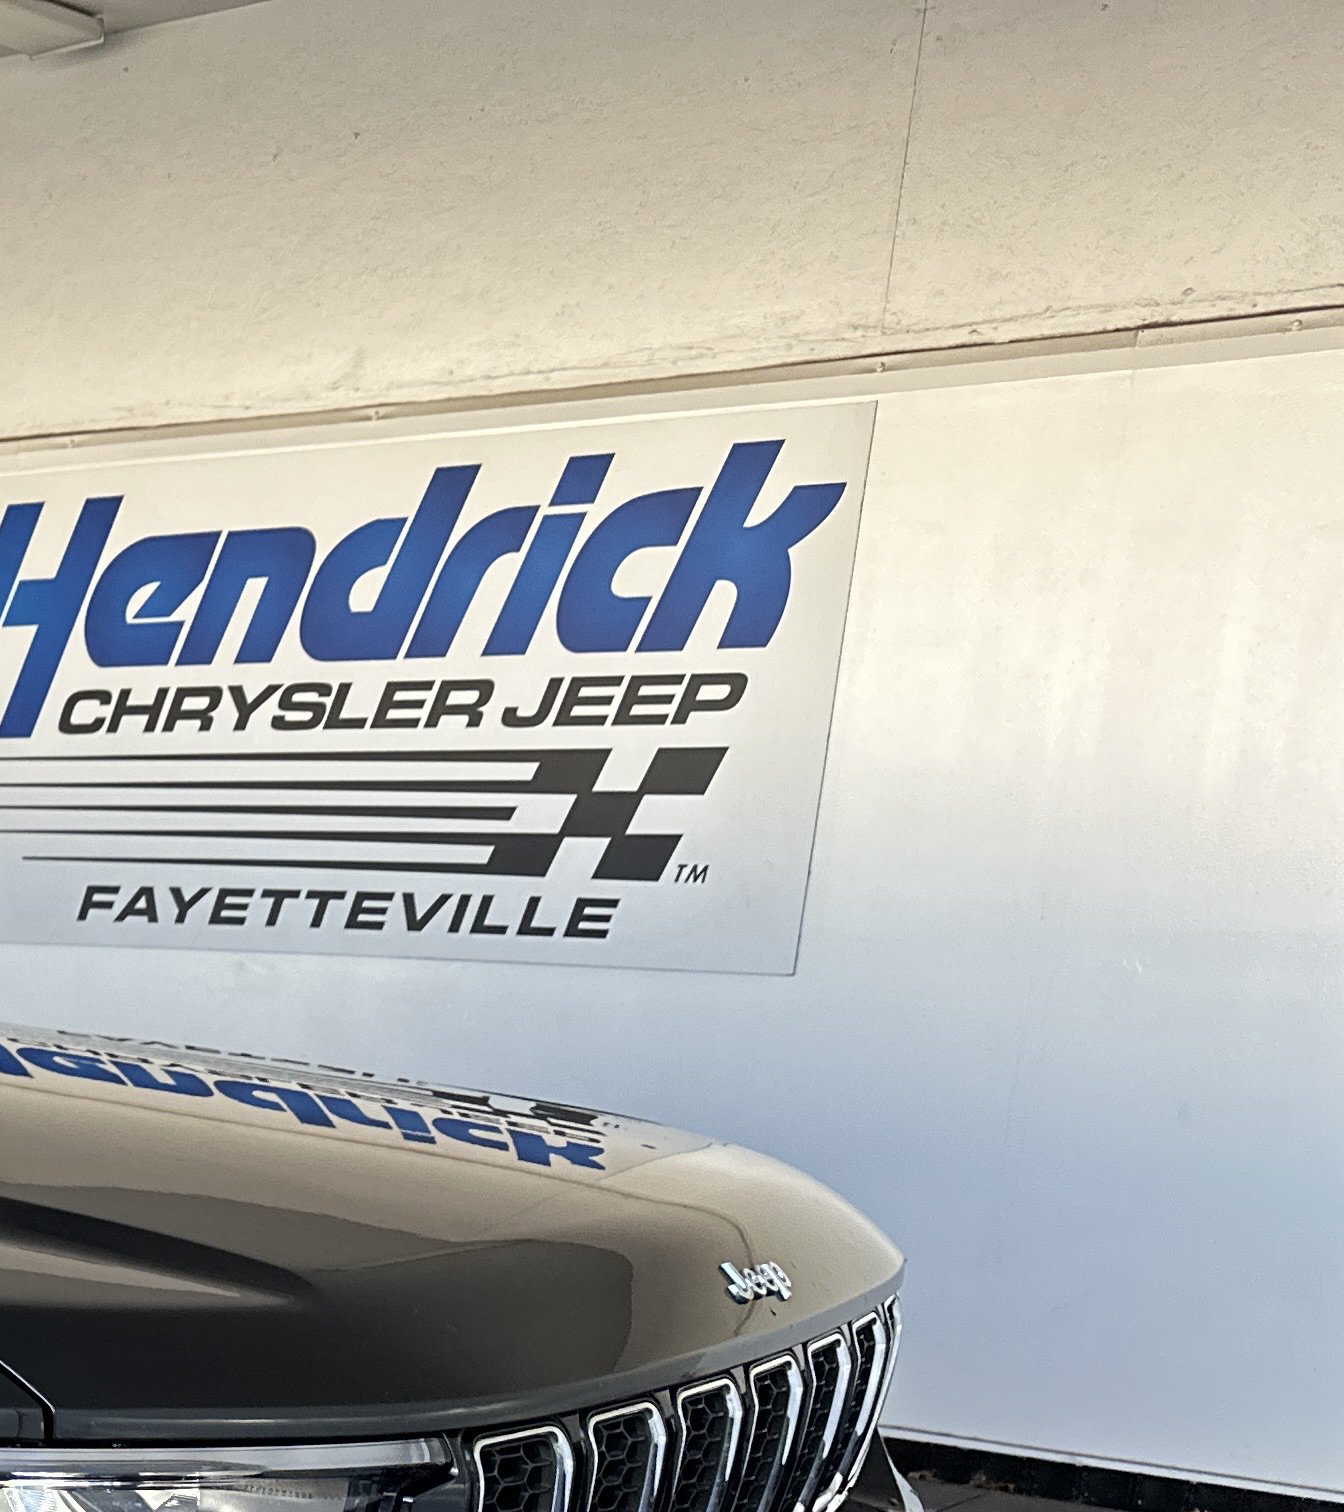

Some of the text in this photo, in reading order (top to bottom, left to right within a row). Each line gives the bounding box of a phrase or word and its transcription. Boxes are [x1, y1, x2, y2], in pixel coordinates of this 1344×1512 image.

[58, 672, 749, 735] CHRYSLER JEEP
[674, 863, 710, 884] TM
[75, 884, 621, 939] FAYETTEVILLE
[719, 1261, 792, 1304] Jeep
